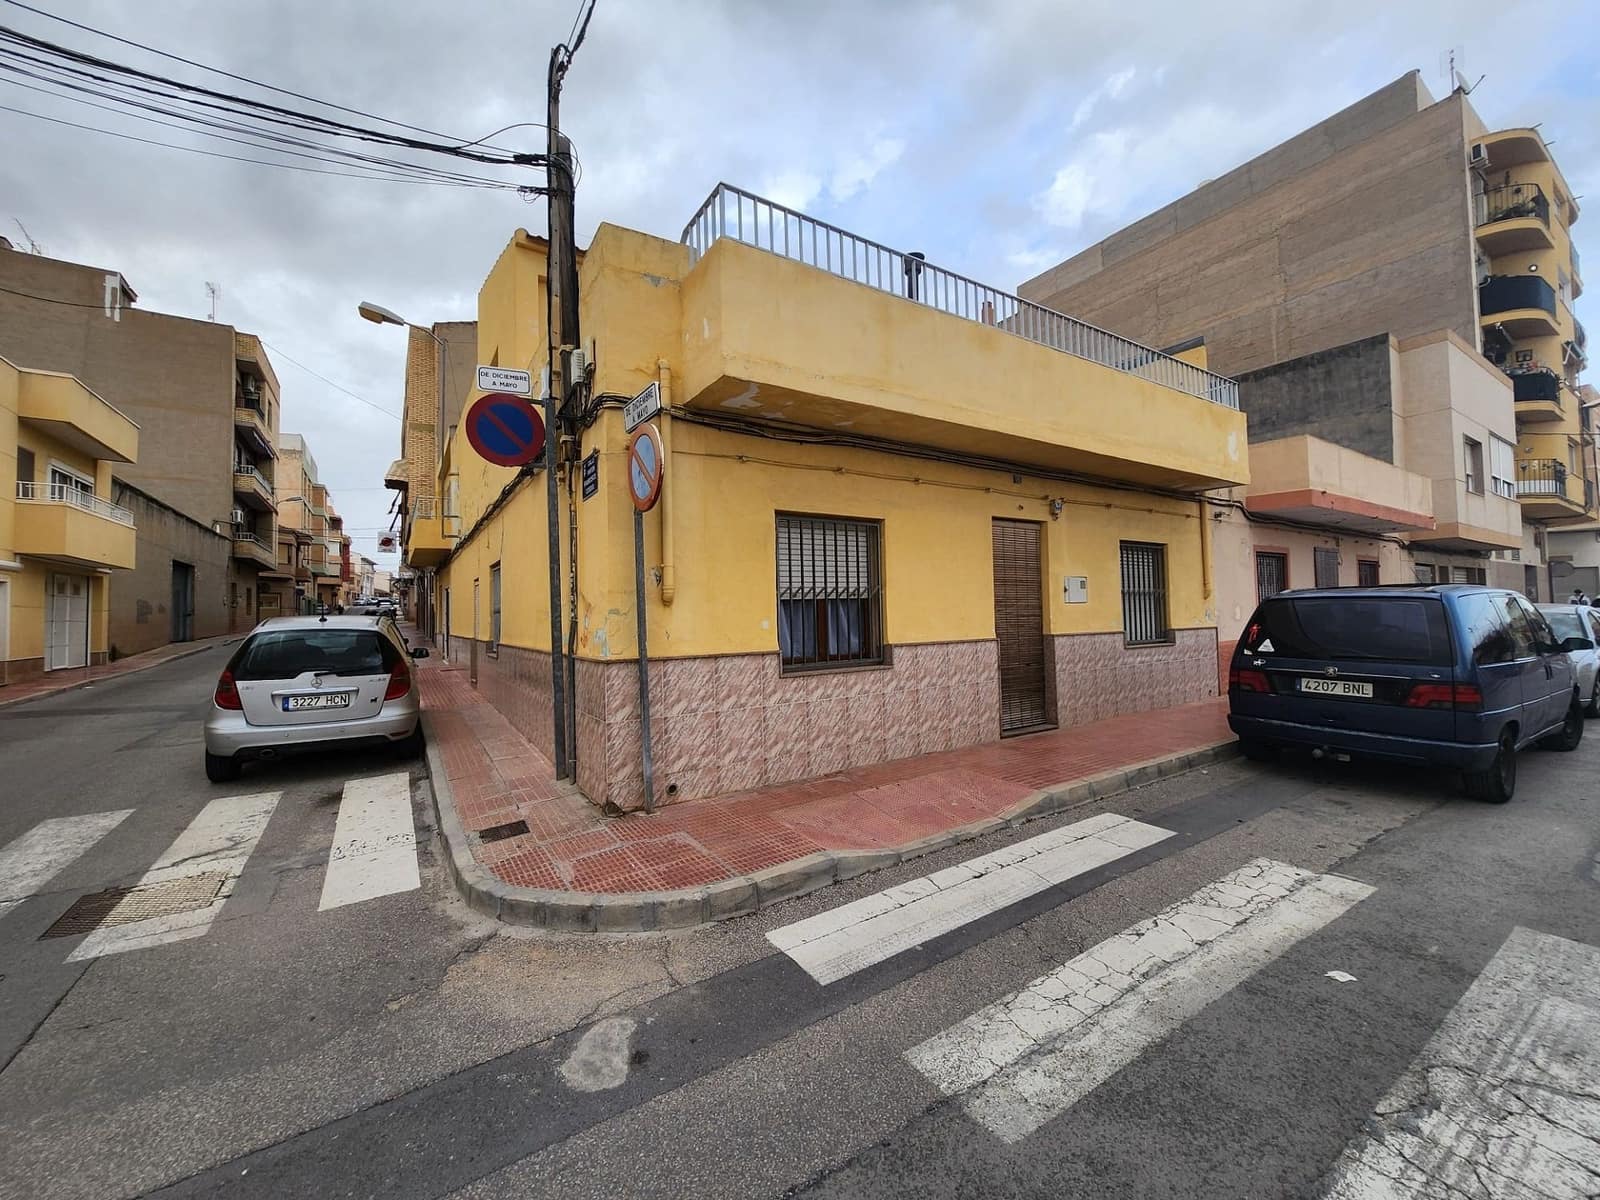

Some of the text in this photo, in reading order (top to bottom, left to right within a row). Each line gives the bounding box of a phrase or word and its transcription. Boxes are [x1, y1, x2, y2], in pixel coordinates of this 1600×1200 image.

[492, 372, 528, 382] DICIEMBRE
[500, 381, 518, 389] MAYO
[1304, 680, 1369, 696] 4207 BNL
[292, 694, 347, 707] 3227 HCN
